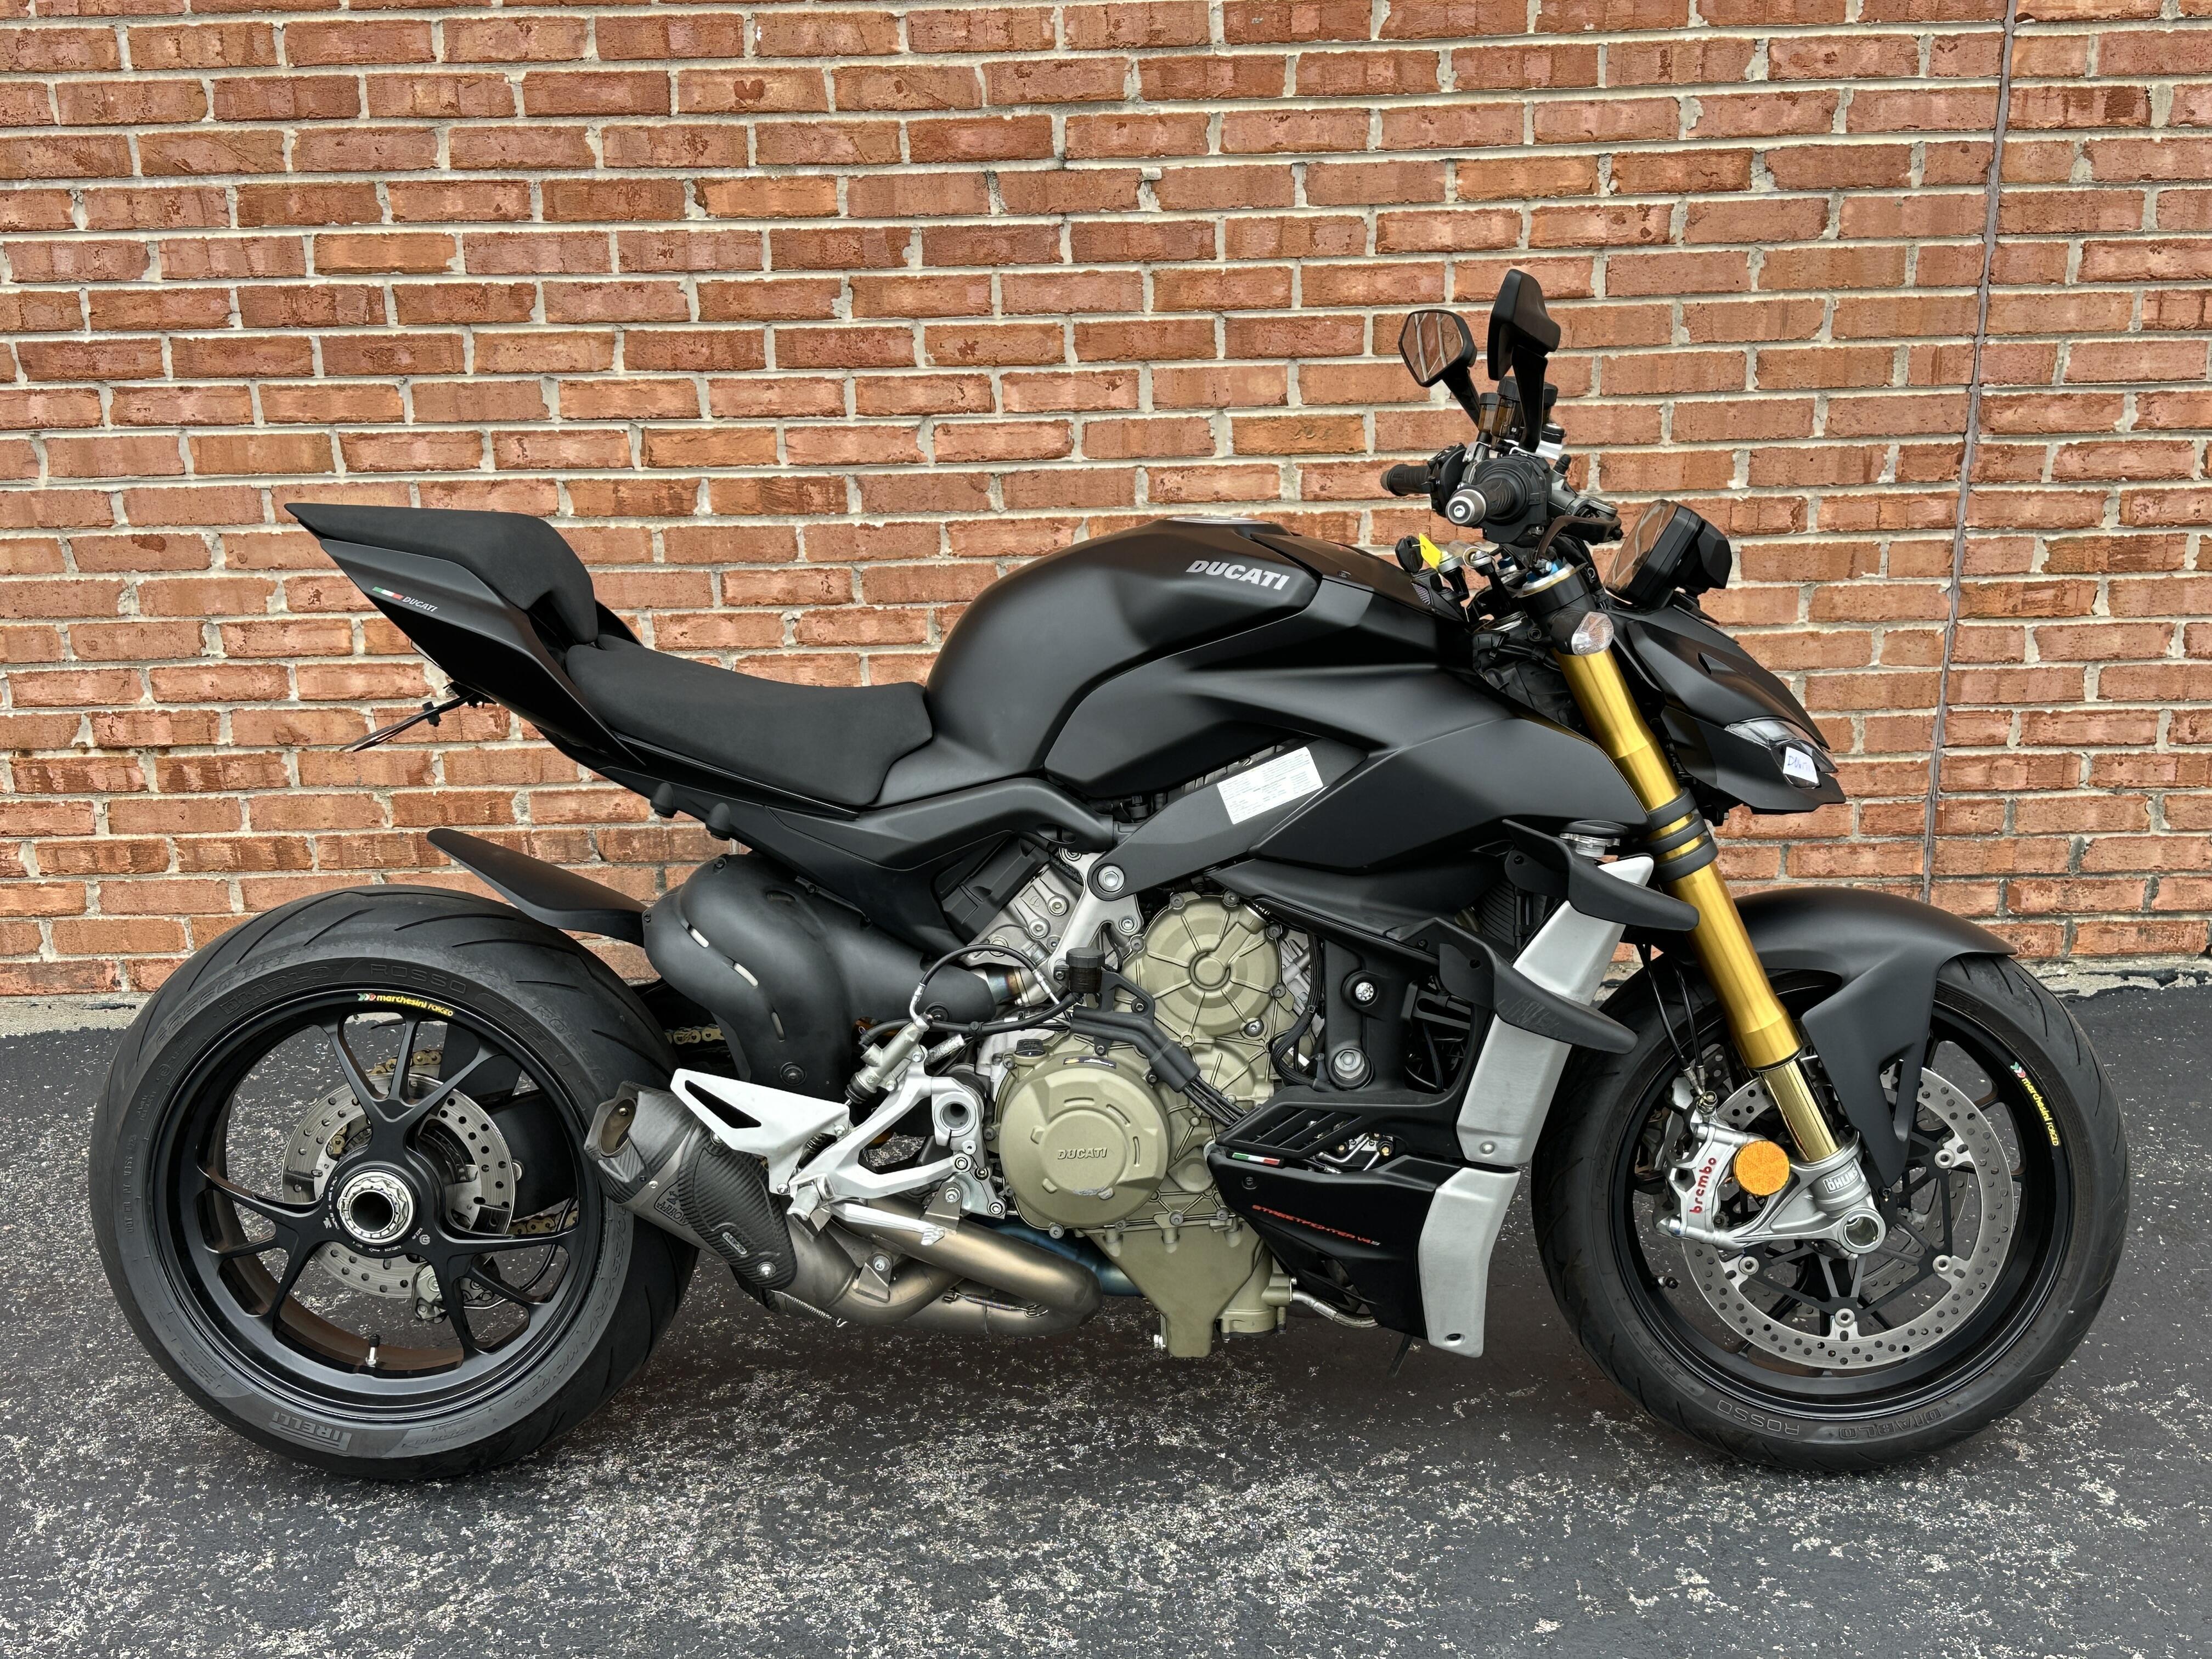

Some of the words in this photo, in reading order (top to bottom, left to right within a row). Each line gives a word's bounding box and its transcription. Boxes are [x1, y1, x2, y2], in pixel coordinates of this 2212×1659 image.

[1185, 560, 1290, 590] DUCATI
[402, 596, 438, 612] DUCATI
[370, 963, 466, 994] ROSSO
[376, 995, 427, 1008] marchesini
[2021, 1077, 2053, 1122] marchesini
[1057, 1147, 1108, 1160] DUCATI
[1689, 1157, 1717, 1214] brembo
[1825, 1166, 1859, 1191] ÖHLINS
[268, 1411, 353, 1452] PIRELLI
[1716, 1399, 1801, 1436] ROSSO
[1838, 1407, 1944, 1440] DIABLO
